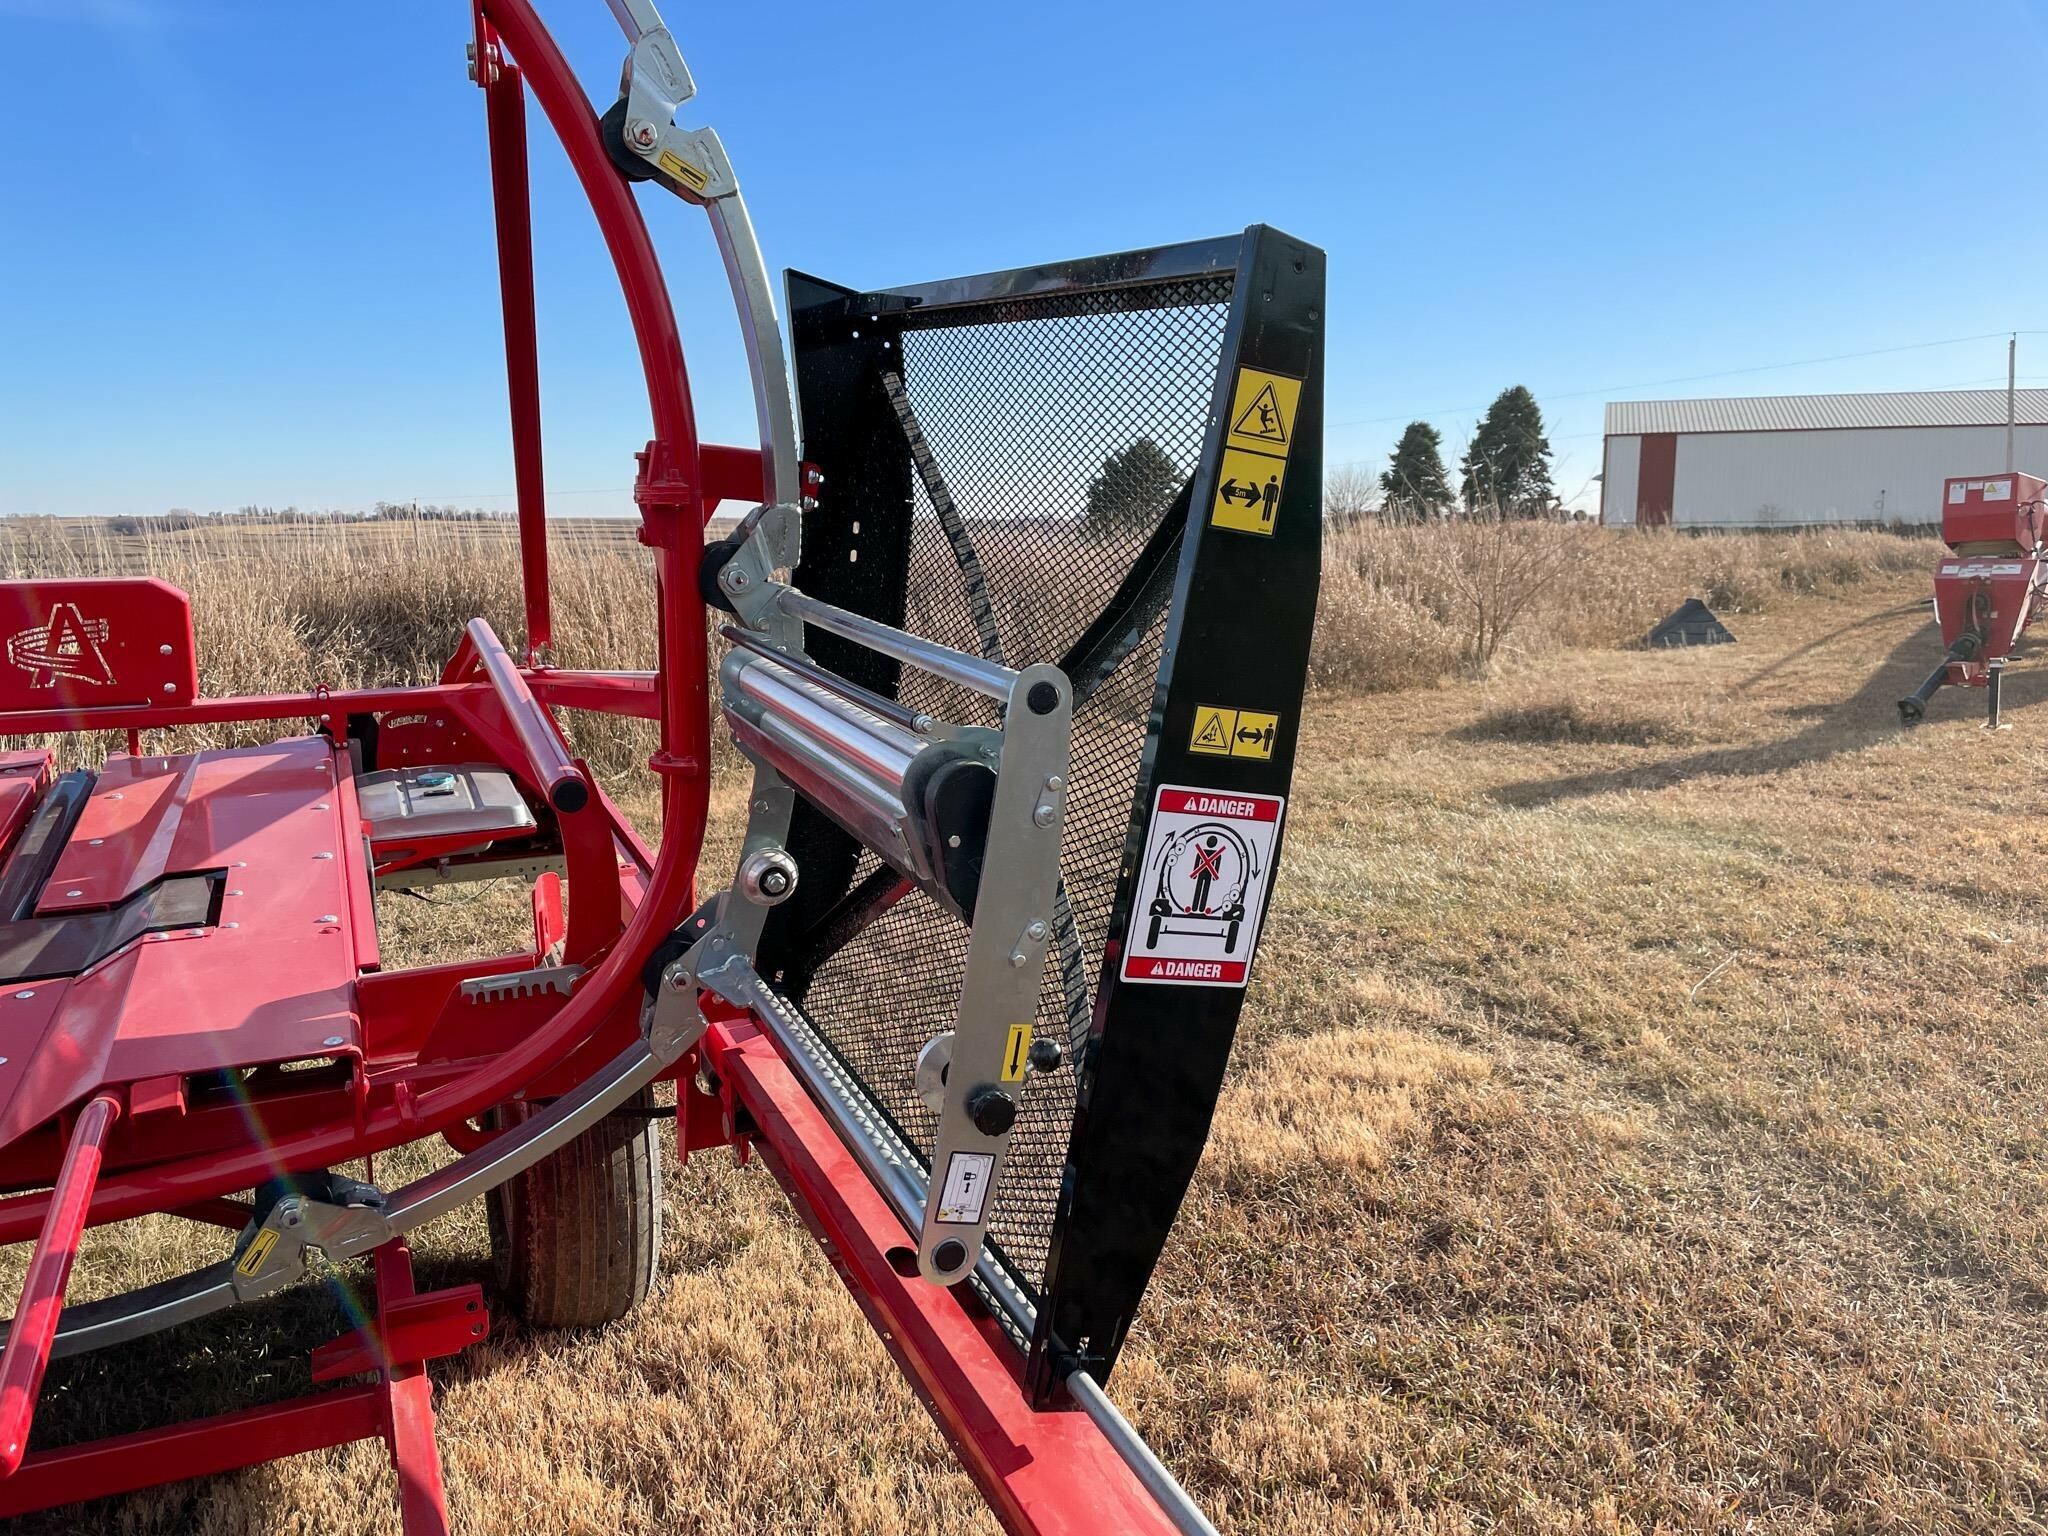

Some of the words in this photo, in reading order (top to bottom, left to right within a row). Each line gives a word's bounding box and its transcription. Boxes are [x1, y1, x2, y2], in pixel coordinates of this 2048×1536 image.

[1235, 488, 1246, 497] 5m
[1198, 797, 1255, 816] DANGER
[1165, 961, 1222, 978] DANGER
